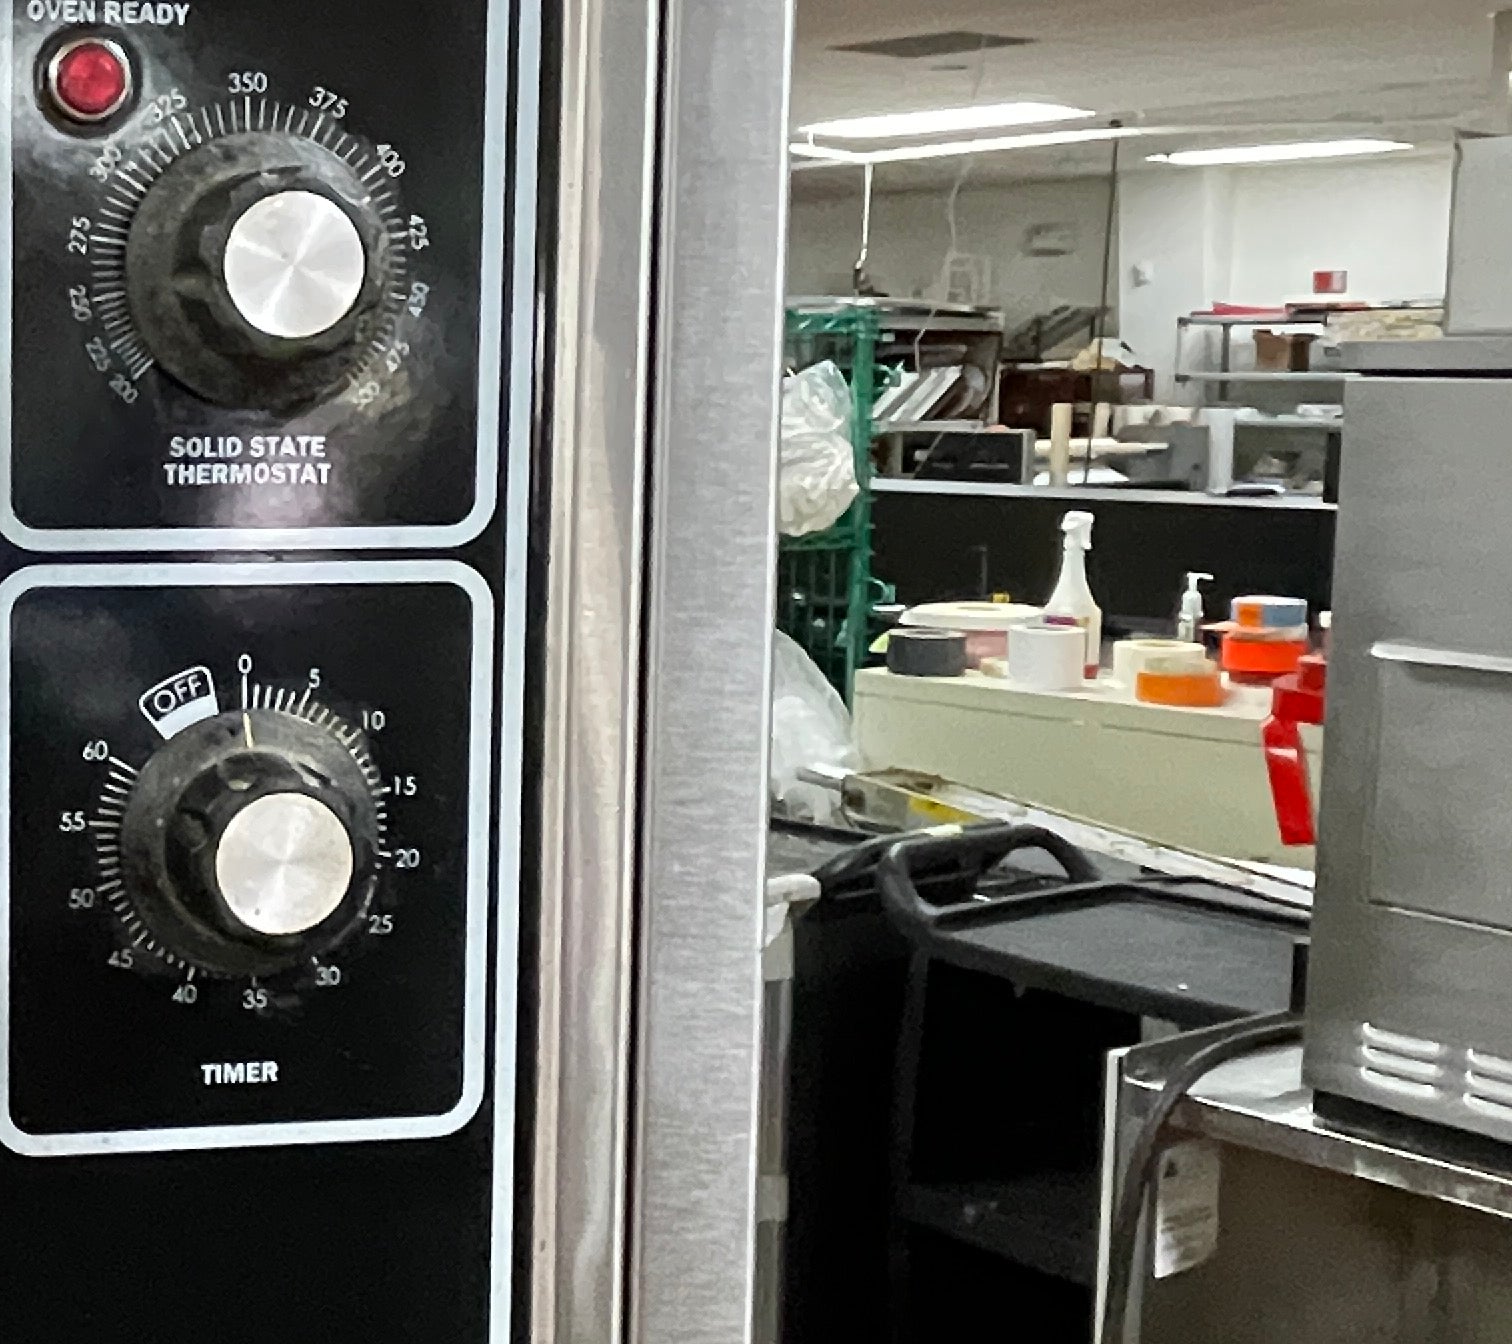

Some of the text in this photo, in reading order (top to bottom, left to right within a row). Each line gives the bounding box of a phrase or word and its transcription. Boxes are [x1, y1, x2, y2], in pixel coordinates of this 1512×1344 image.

[27, 0, 190, 27] OVEN READY
[228, 72, 268, 94] 350
[148, 87, 188, 123] 325
[308, 86, 350, 120] 375
[89, 141, 122, 184] 300
[376, 144, 406, 178] 400
[68, 216, 91, 256] 275
[408, 214, 430, 250] 425
[69, 284, 92, 322] 250
[169, 436, 326, 458] SOLID STATE
[163, 463, 332, 487] THERMOSTAT
[237, 654, 253, 674] 0
[308, 668, 322, 689] 5
[153, 676, 202, 712] OFF
[361, 710, 386, 730] 10
[82, 741, 109, 761] 60
[392, 776, 418, 796] 15
[59, 812, 86, 832] 55
[395, 849, 420, 869] 20
[68, 888, 95, 909] 50
[368, 914, 394, 934] 25
[107, 953, 134, 969] 45
[314, 966, 341, 987] 30
[172, 984, 198, 1005] 40
[242, 988, 268, 1009] 35
[201, 1061, 279, 1086] TIMER
